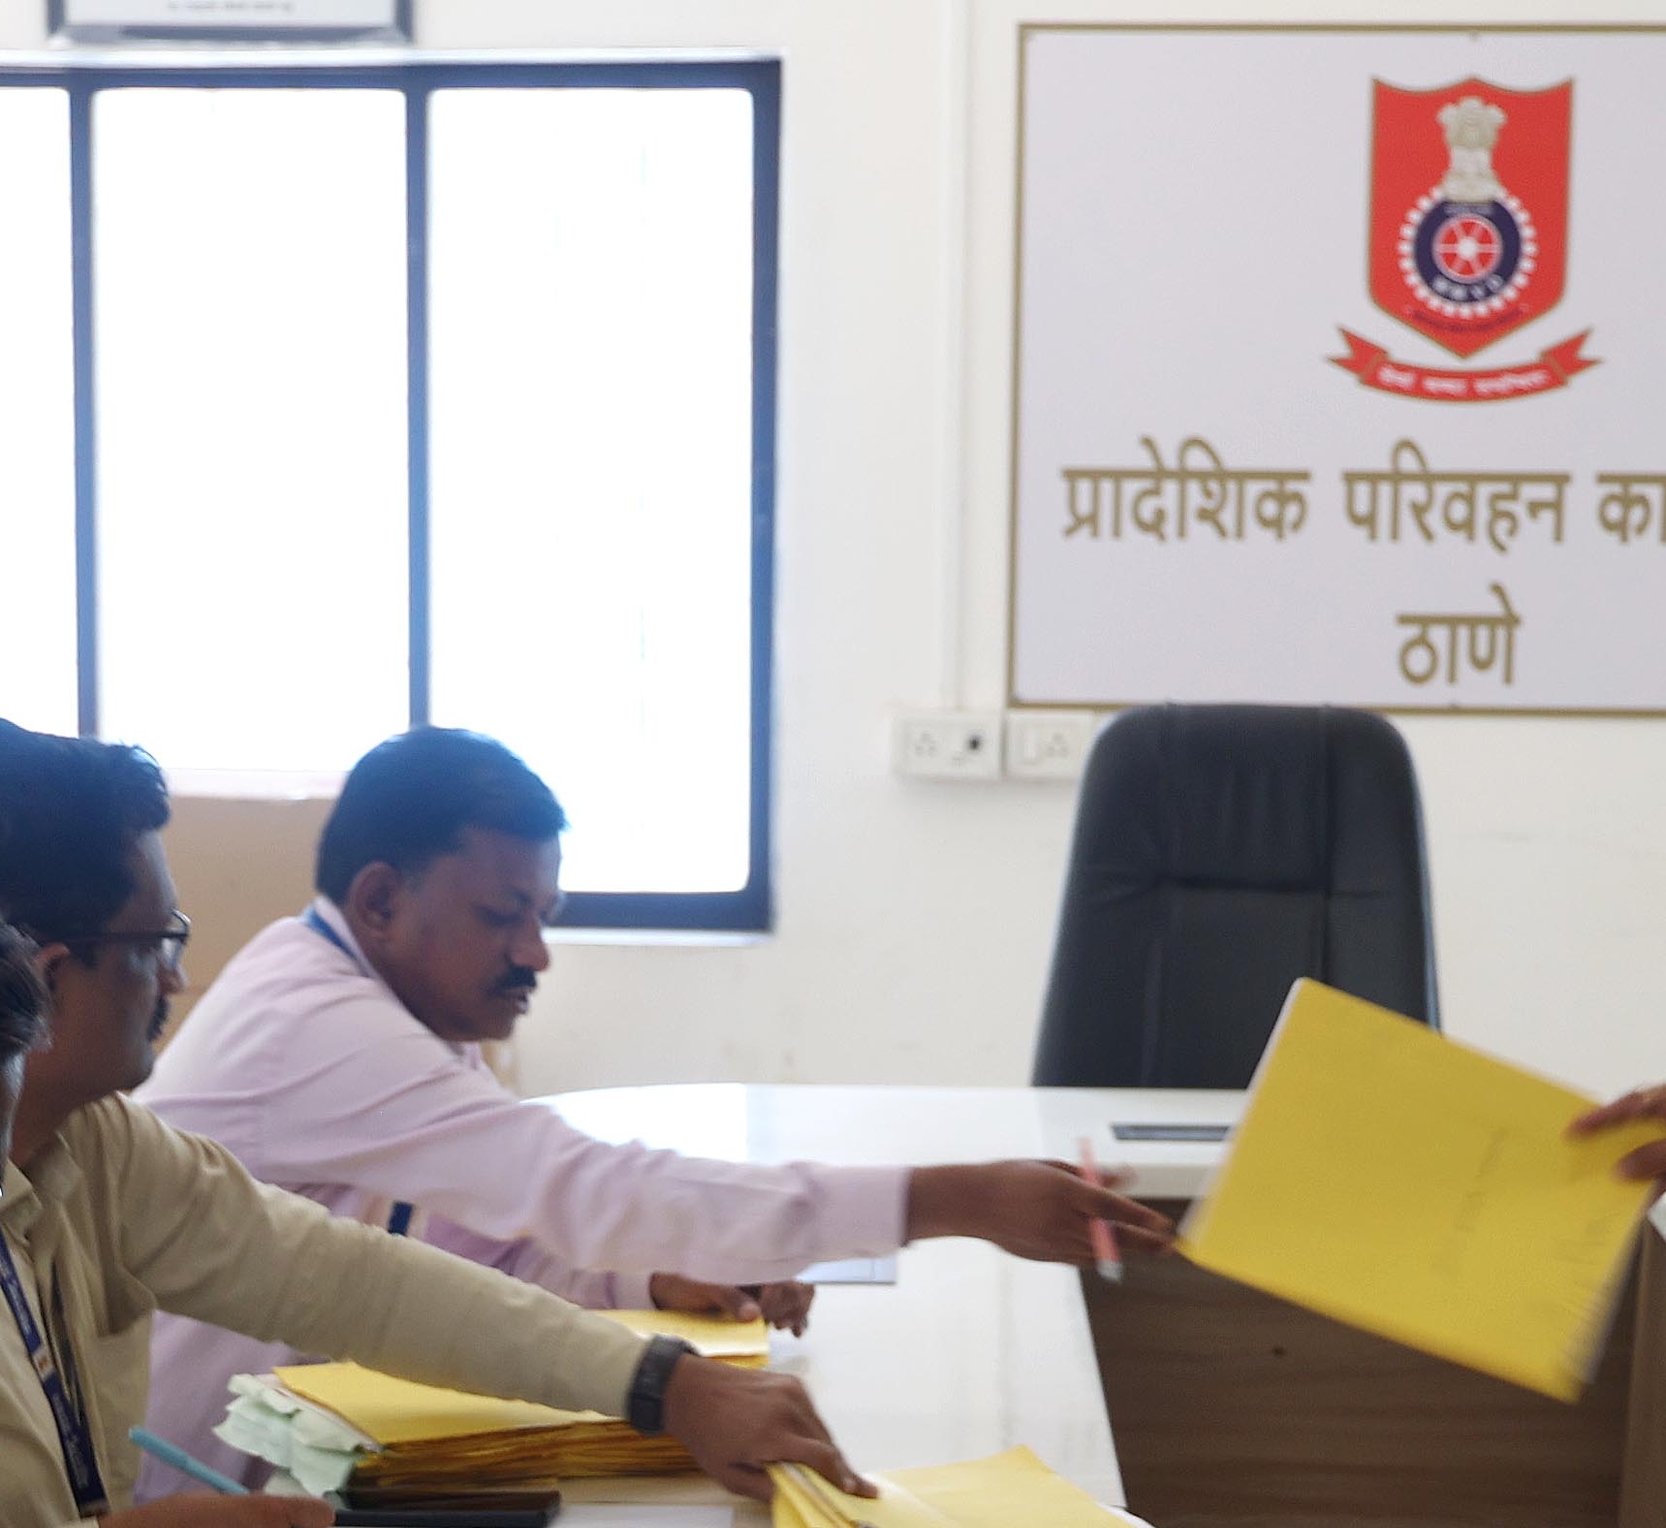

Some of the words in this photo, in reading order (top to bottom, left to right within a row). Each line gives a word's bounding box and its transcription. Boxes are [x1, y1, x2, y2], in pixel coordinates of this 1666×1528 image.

[1061, 436, 1311, 542] प्रादेशिक
[1341, 439, 1571, 554] परिवहन
[1394, 583, 1523, 686] ठाणे
